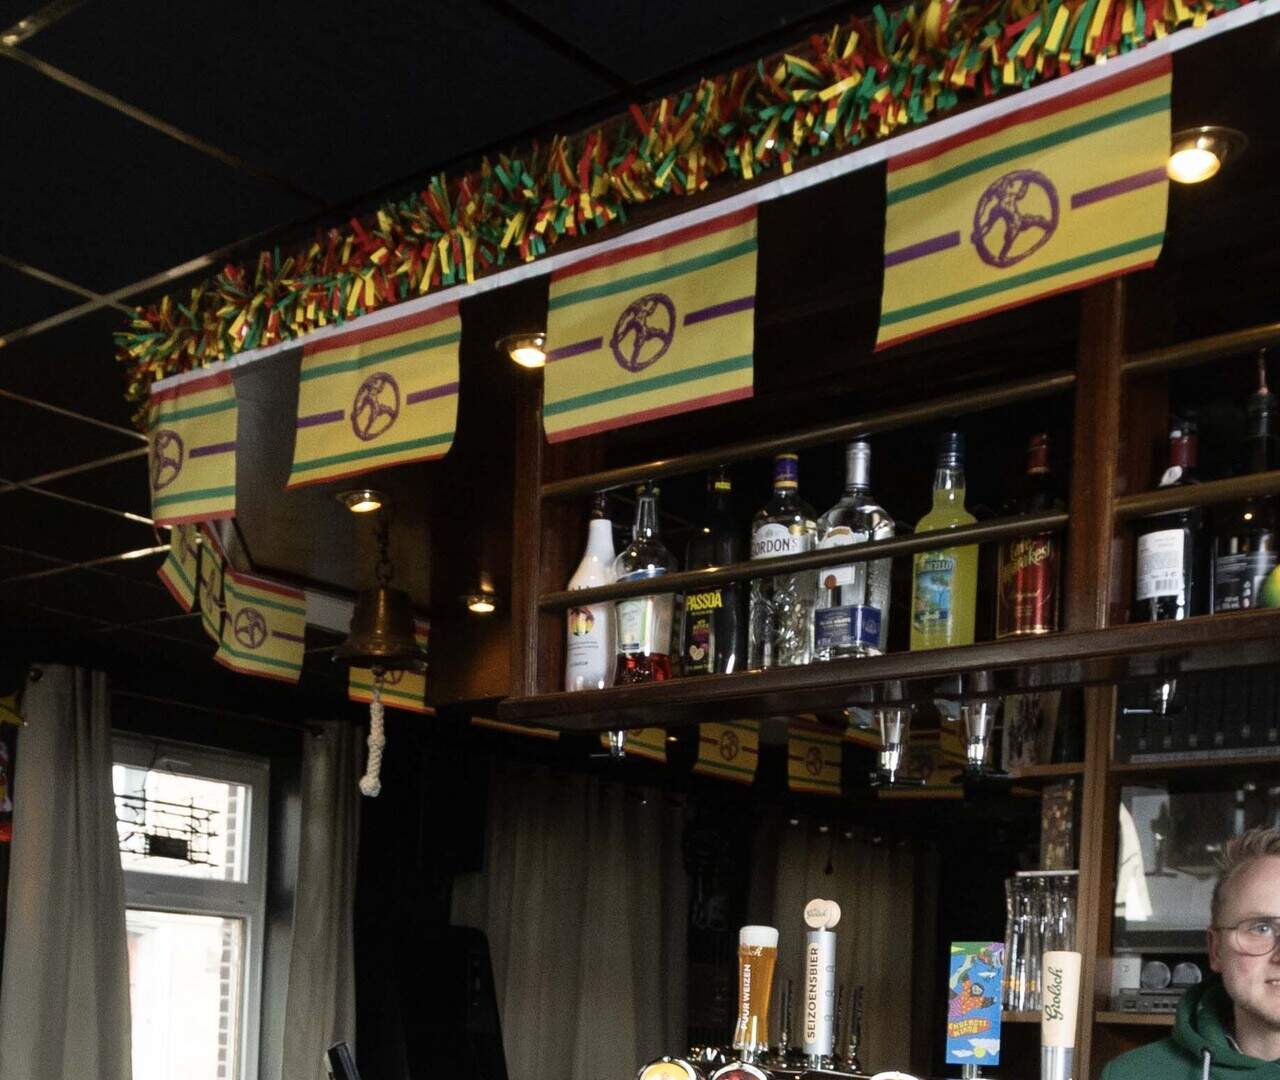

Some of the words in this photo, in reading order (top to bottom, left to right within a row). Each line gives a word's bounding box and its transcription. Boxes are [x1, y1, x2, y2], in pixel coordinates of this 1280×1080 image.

[743, 964, 752, 1002] WEIZEN
[807, 947, 819, 1039] SEIZOENSBIER
[1045, 966, 1064, 1021] Grolsch
